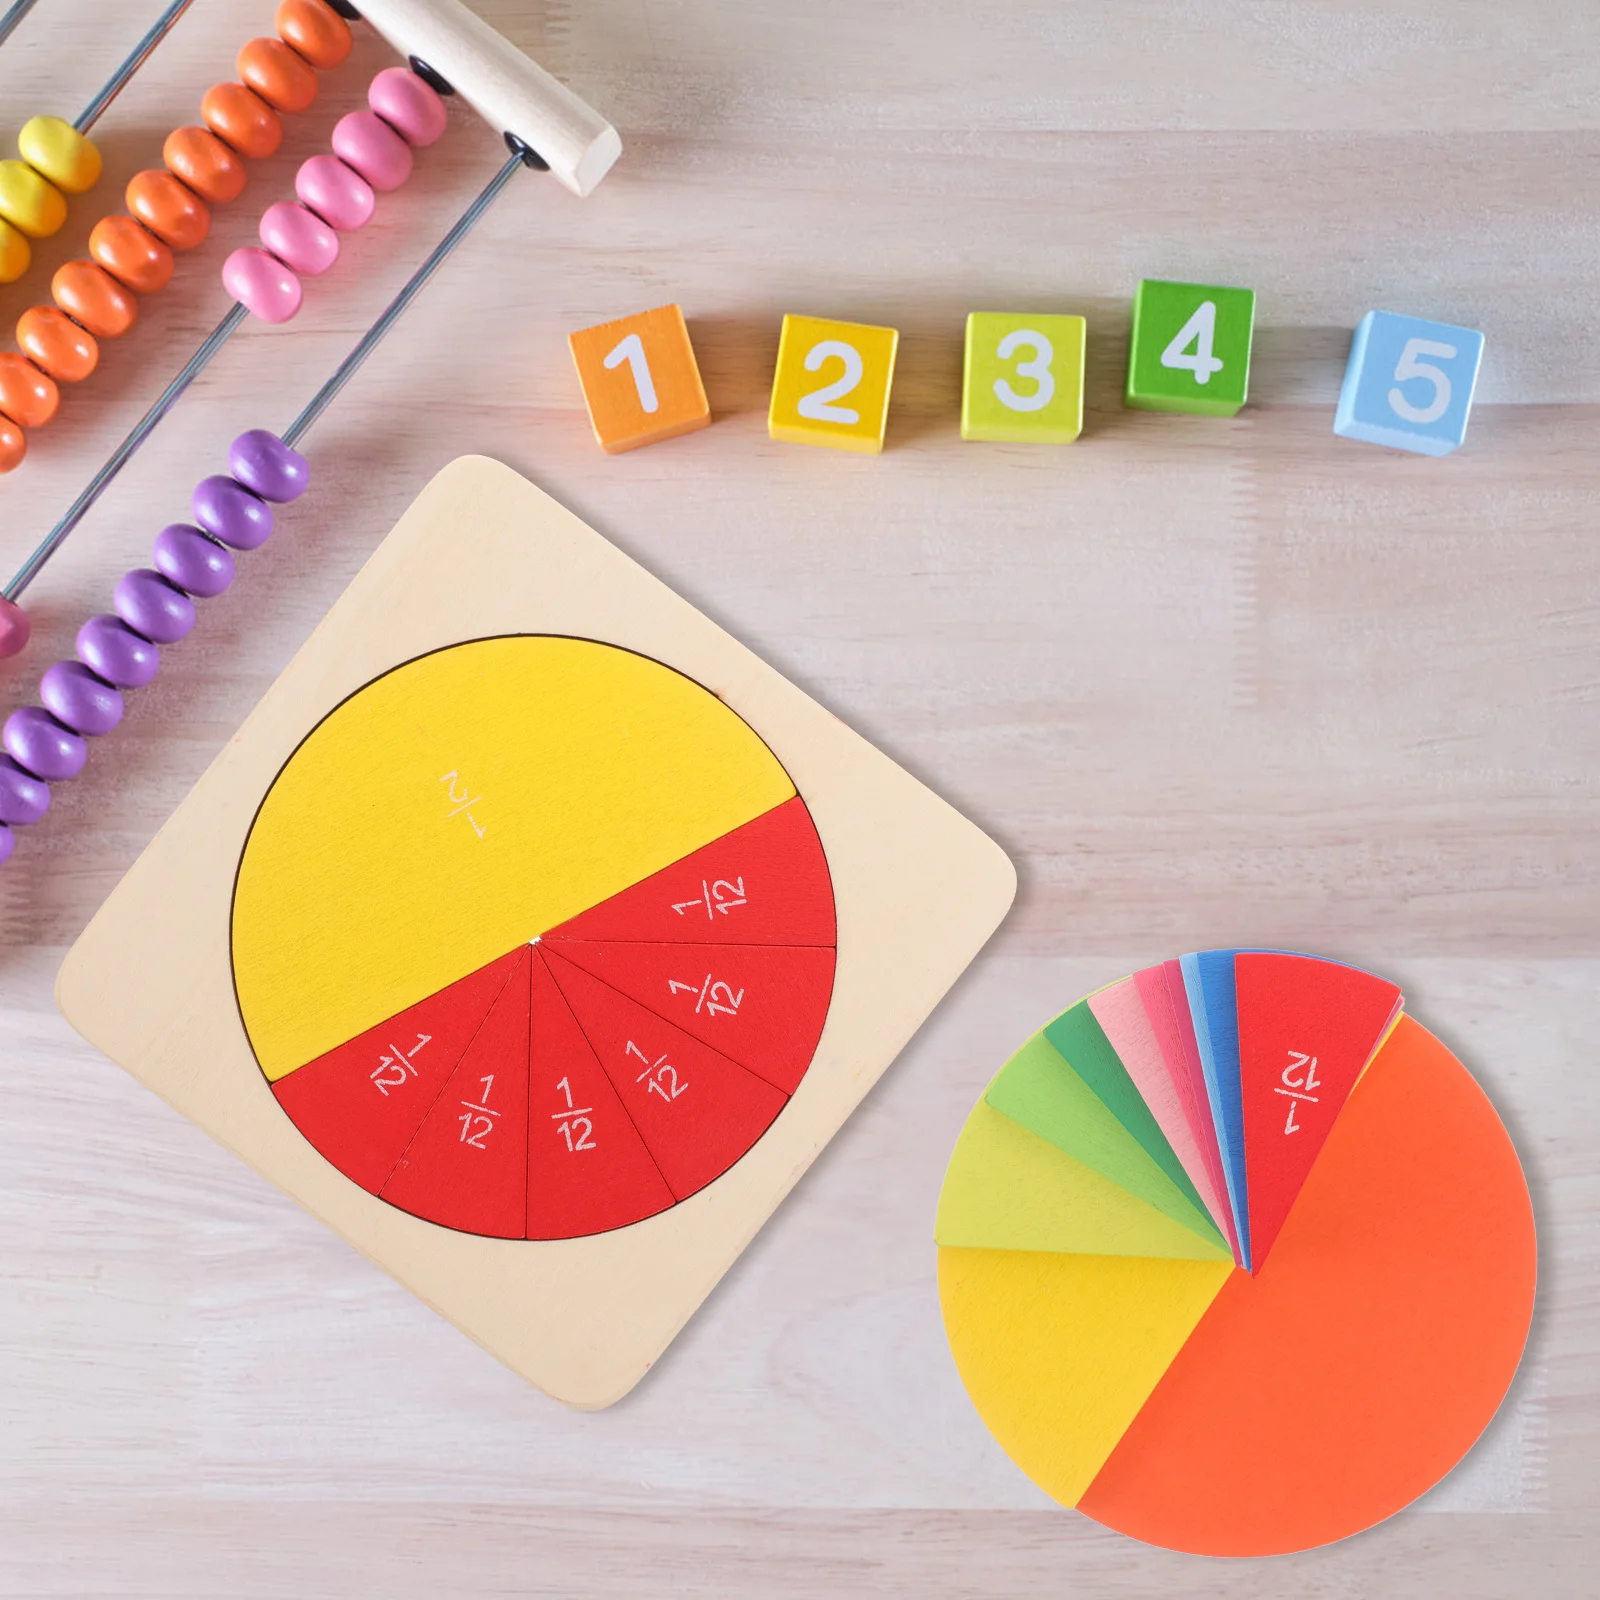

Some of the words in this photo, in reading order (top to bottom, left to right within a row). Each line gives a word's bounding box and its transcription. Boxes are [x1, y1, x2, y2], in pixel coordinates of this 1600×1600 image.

[603, 333, 659, 413] 1
[797, 340, 863, 425] 2
[993, 329, 1055, 412] 3
[1161, 301, 1224, 385] 4
[1389, 338, 1455, 423] 5
